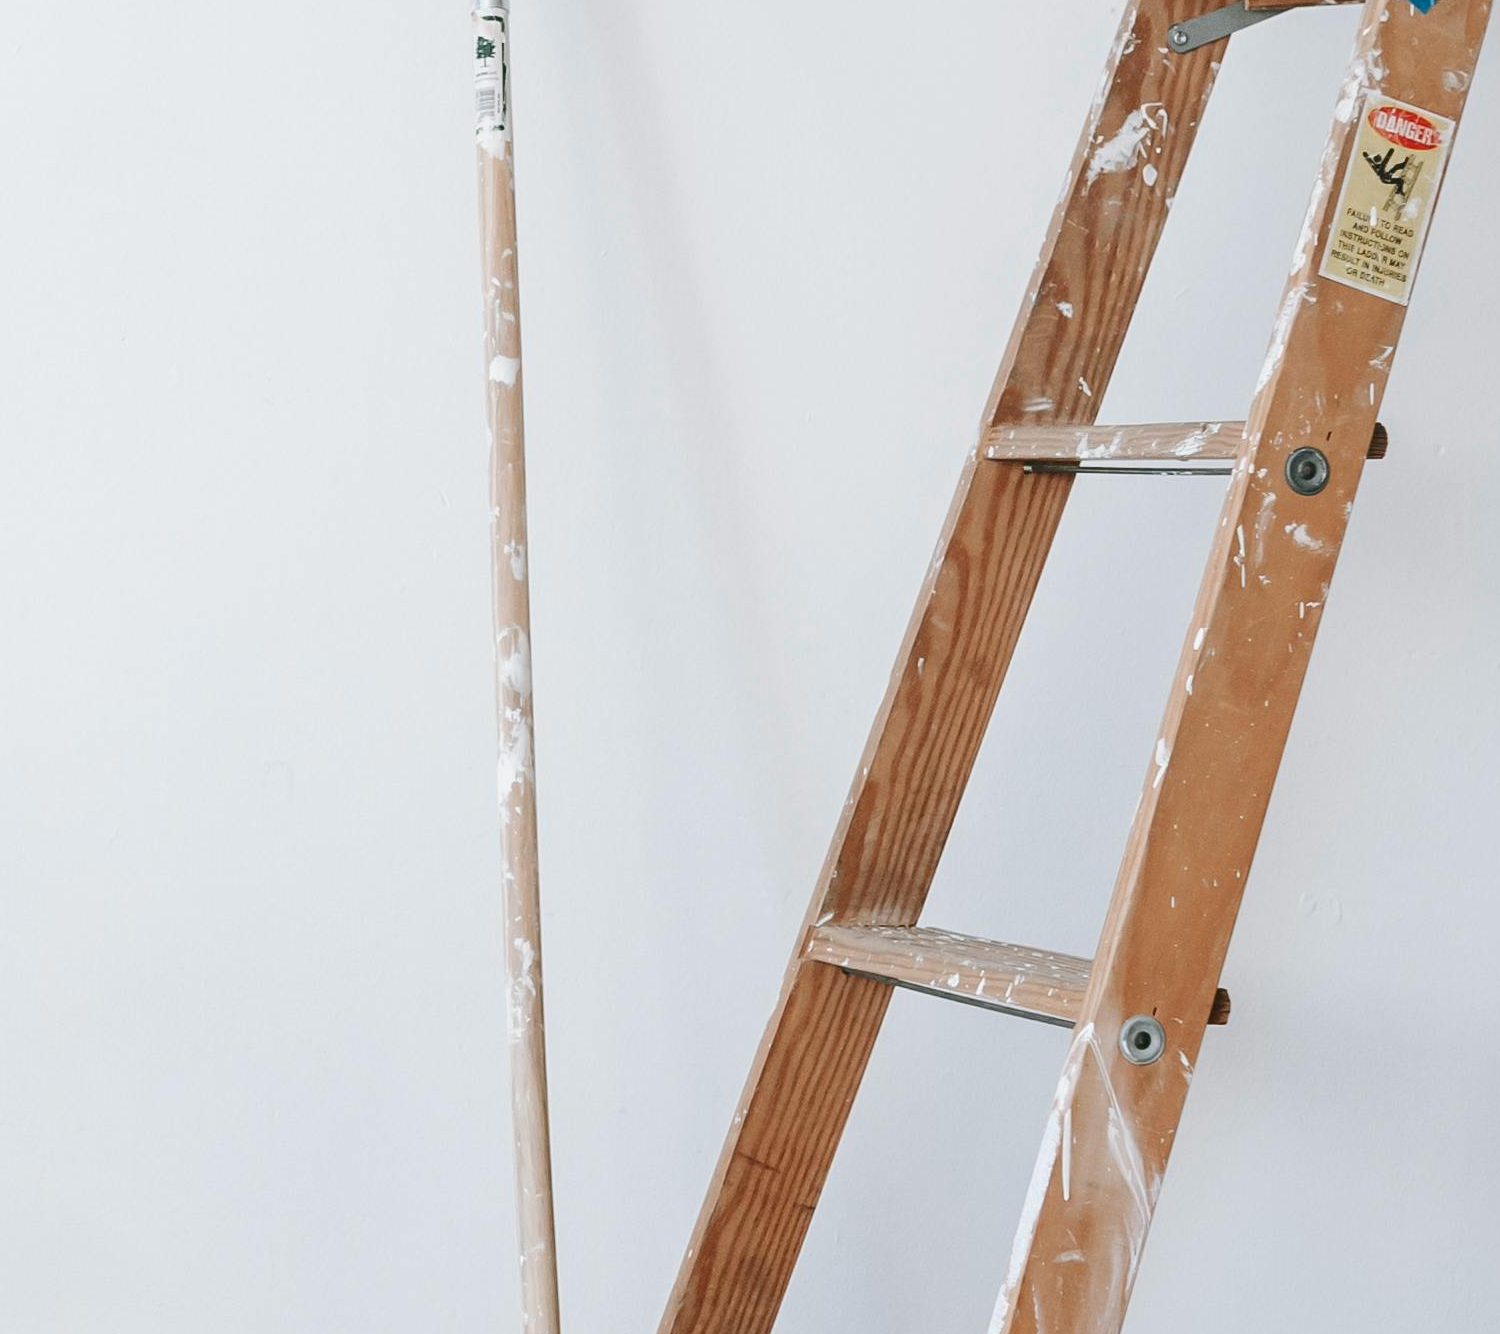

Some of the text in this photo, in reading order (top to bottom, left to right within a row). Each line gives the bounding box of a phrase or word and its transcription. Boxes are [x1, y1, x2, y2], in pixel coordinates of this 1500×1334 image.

[1375, 111, 1434, 146] DANGER
[1352, 222, 1402, 245] AND FOLLOW
[1381, 219, 1391, 230] TO
[1330, 249, 1360, 265] RESULT
[1361, 260, 1370, 270] IN
[1345, 267, 1358, 278] OR
